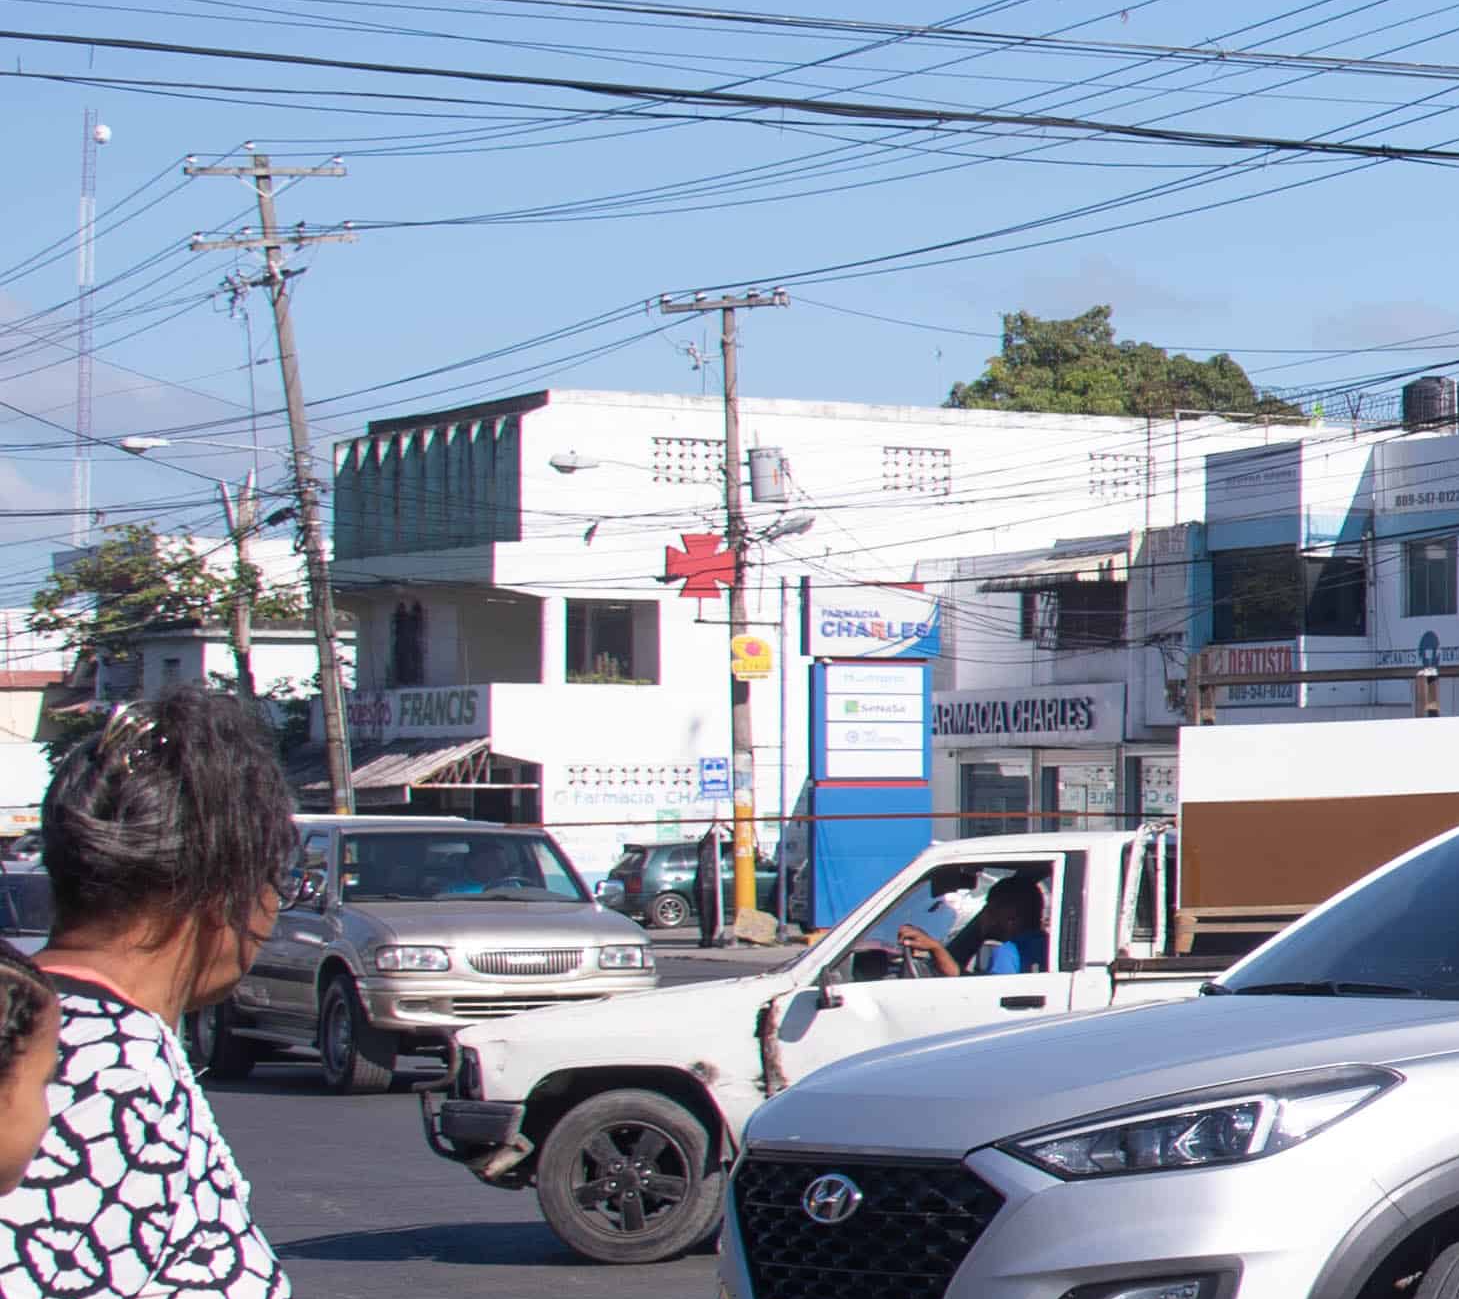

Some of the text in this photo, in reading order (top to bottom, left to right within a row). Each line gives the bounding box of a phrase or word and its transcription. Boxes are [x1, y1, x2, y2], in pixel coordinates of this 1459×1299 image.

[822, 609, 880, 619] FARMACIA
[821, 621, 930, 640] CHARLES
[400, 689, 479, 727] FRANCIS
[931, 696, 1097, 736] ARMACIA CHARLES
